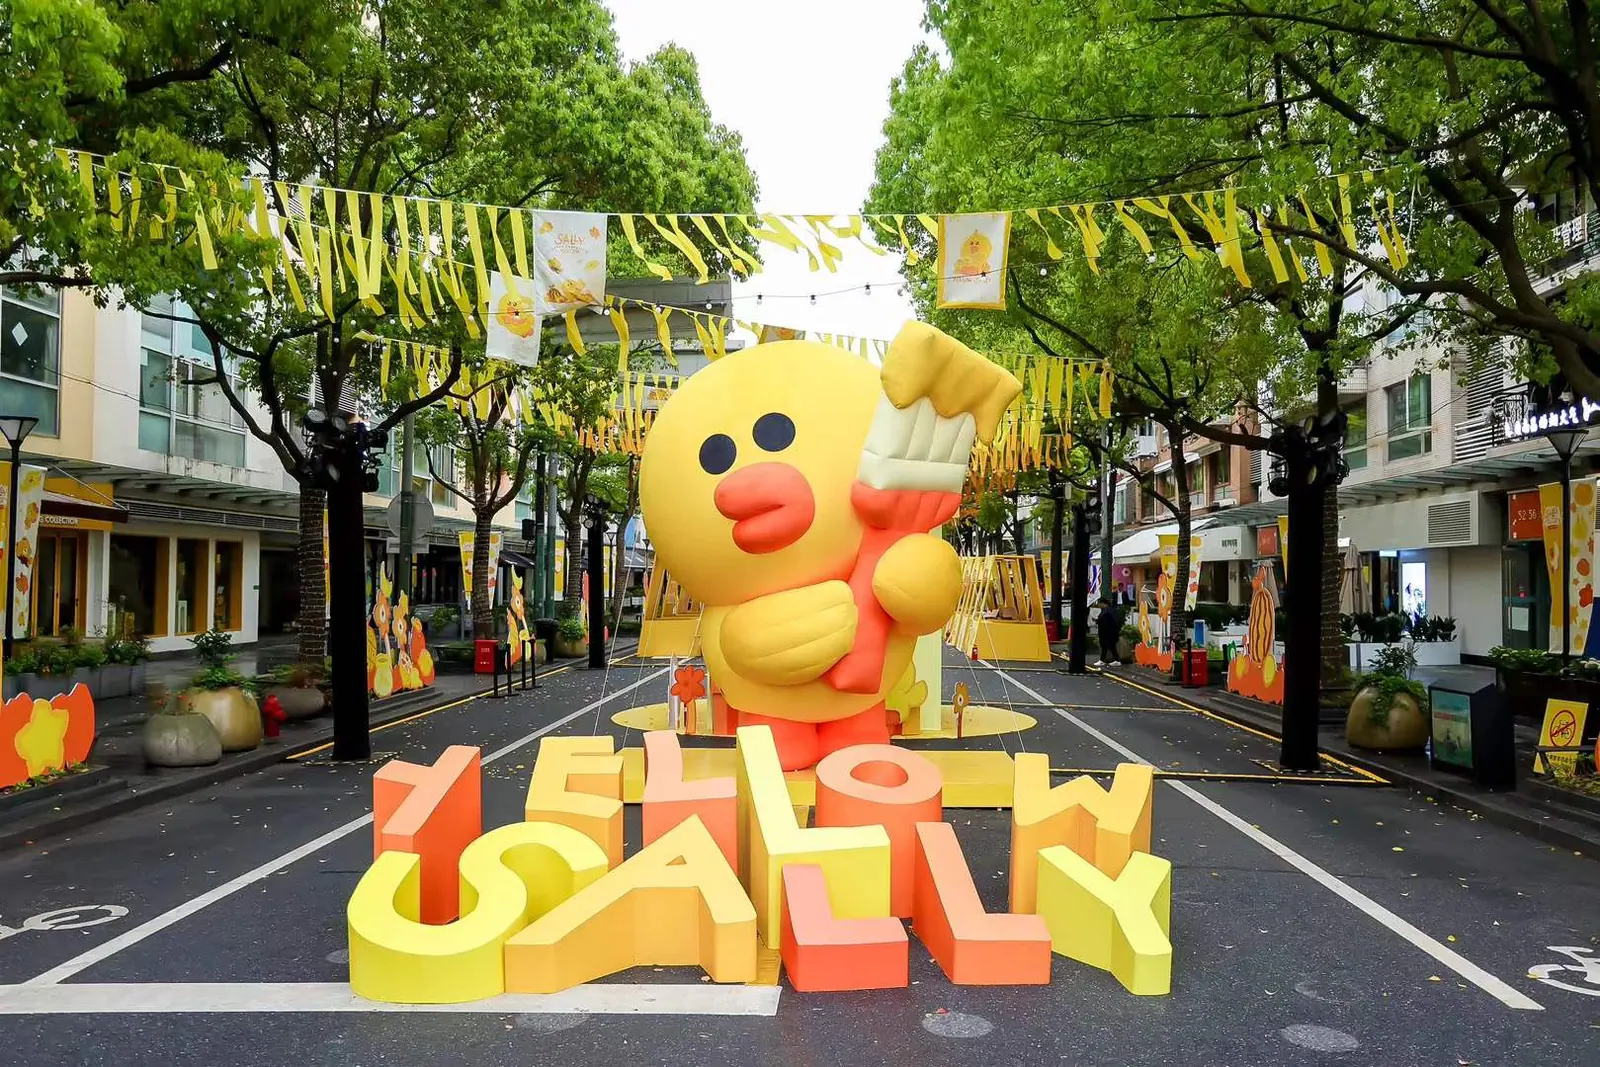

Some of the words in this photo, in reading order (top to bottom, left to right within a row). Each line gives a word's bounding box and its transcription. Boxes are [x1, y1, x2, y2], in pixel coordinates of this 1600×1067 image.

[44, 515, 80, 525] COLLECTION
[347, 815, 1172, 1000] SALLY
[373, 725, 1153, 915] YELLOW
